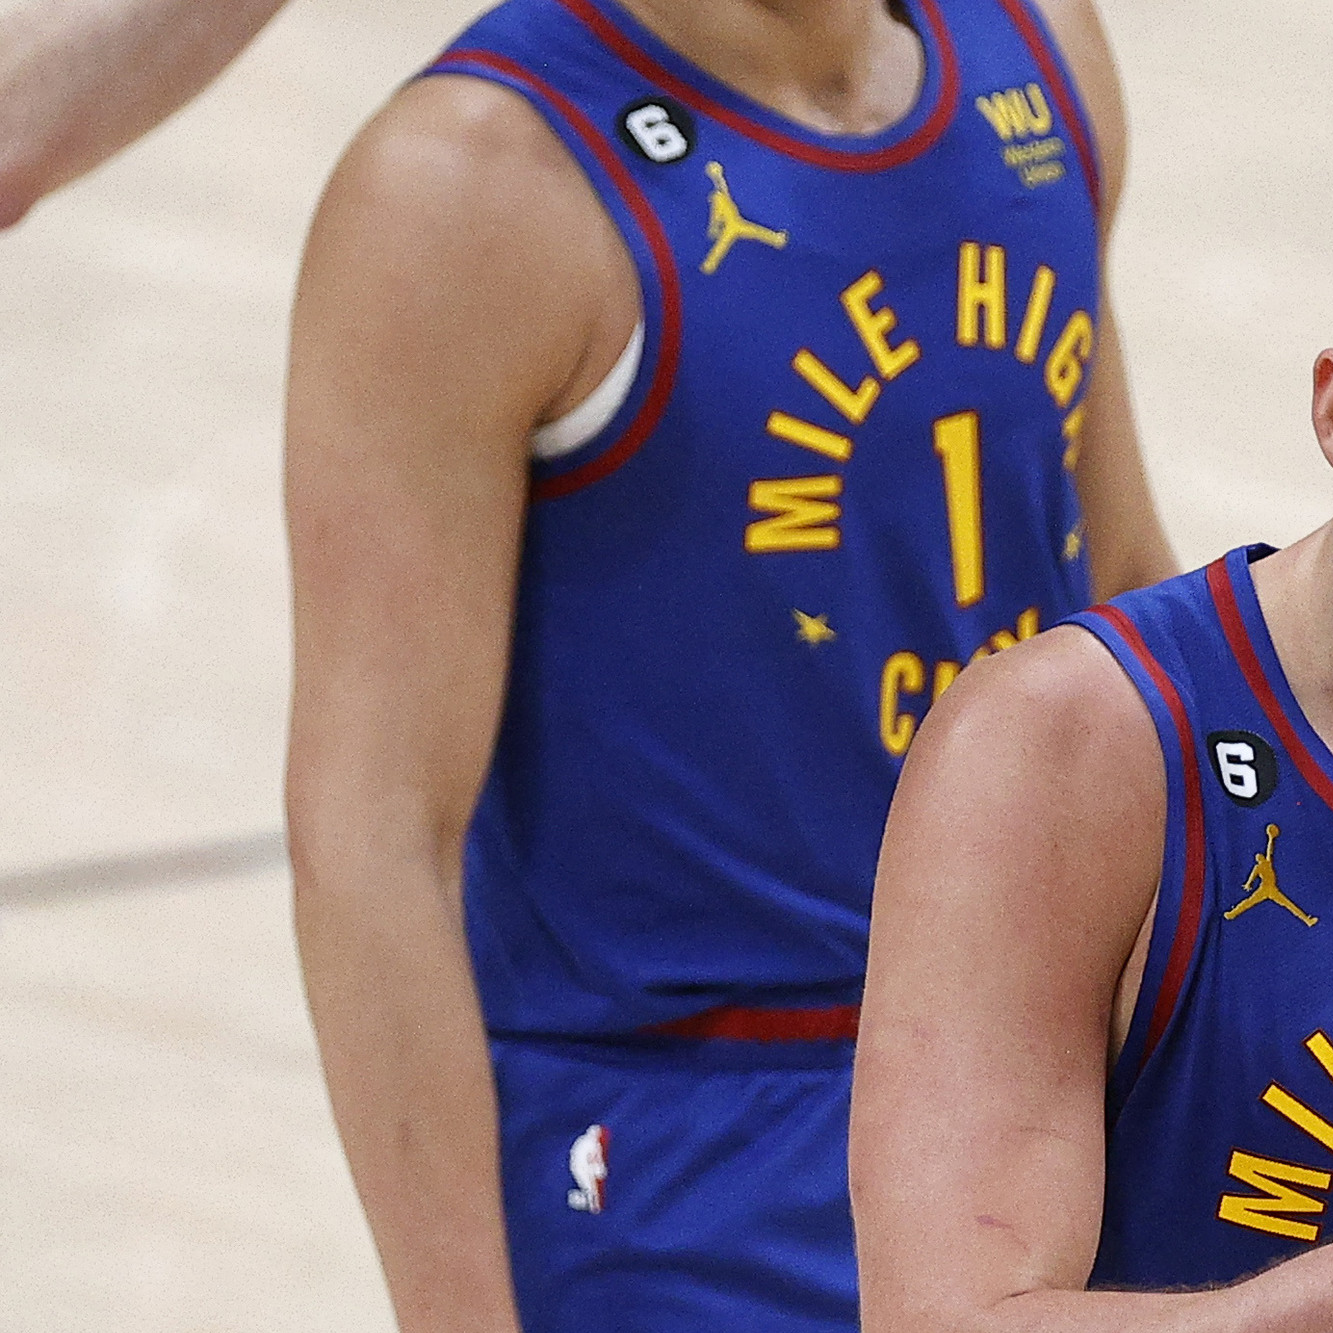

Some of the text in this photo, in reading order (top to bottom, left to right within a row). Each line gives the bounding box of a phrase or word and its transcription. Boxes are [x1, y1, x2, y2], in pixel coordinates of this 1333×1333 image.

[626, 104, 688, 162] 6
[975, 82, 1053, 141] WU
[744, 238, 1094, 555] MILE HIG
[932, 408, 986, 609] 1
[1215, 742, 1258, 798] 6
